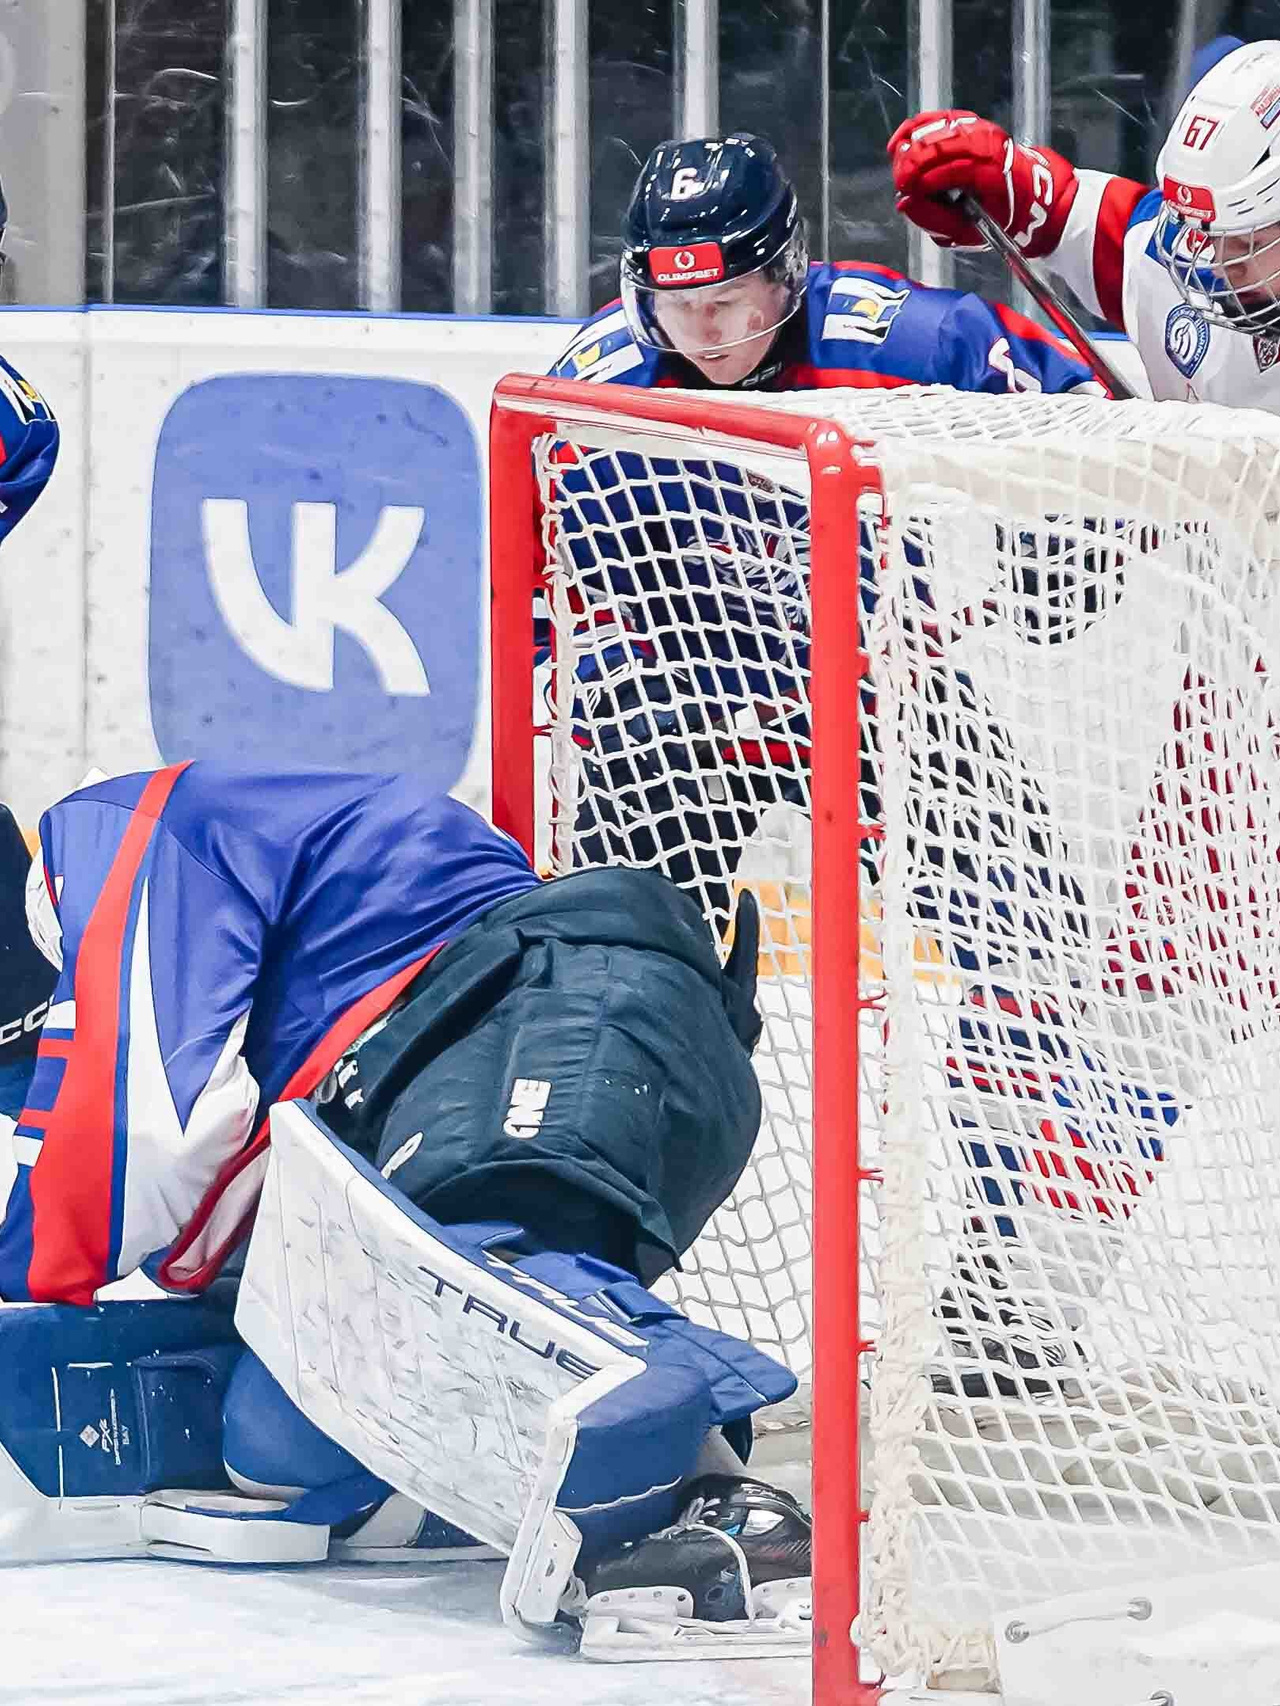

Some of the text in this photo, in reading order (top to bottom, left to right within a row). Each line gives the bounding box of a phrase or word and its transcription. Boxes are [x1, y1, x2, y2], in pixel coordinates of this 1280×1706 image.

[1183, 115, 1219, 150] 67
[671, 167, 707, 200] 6
[657, 268, 719, 283] OLIMPBET
[202, 498, 431, 696] VK
[418, 1265, 603, 1381] TRUE
